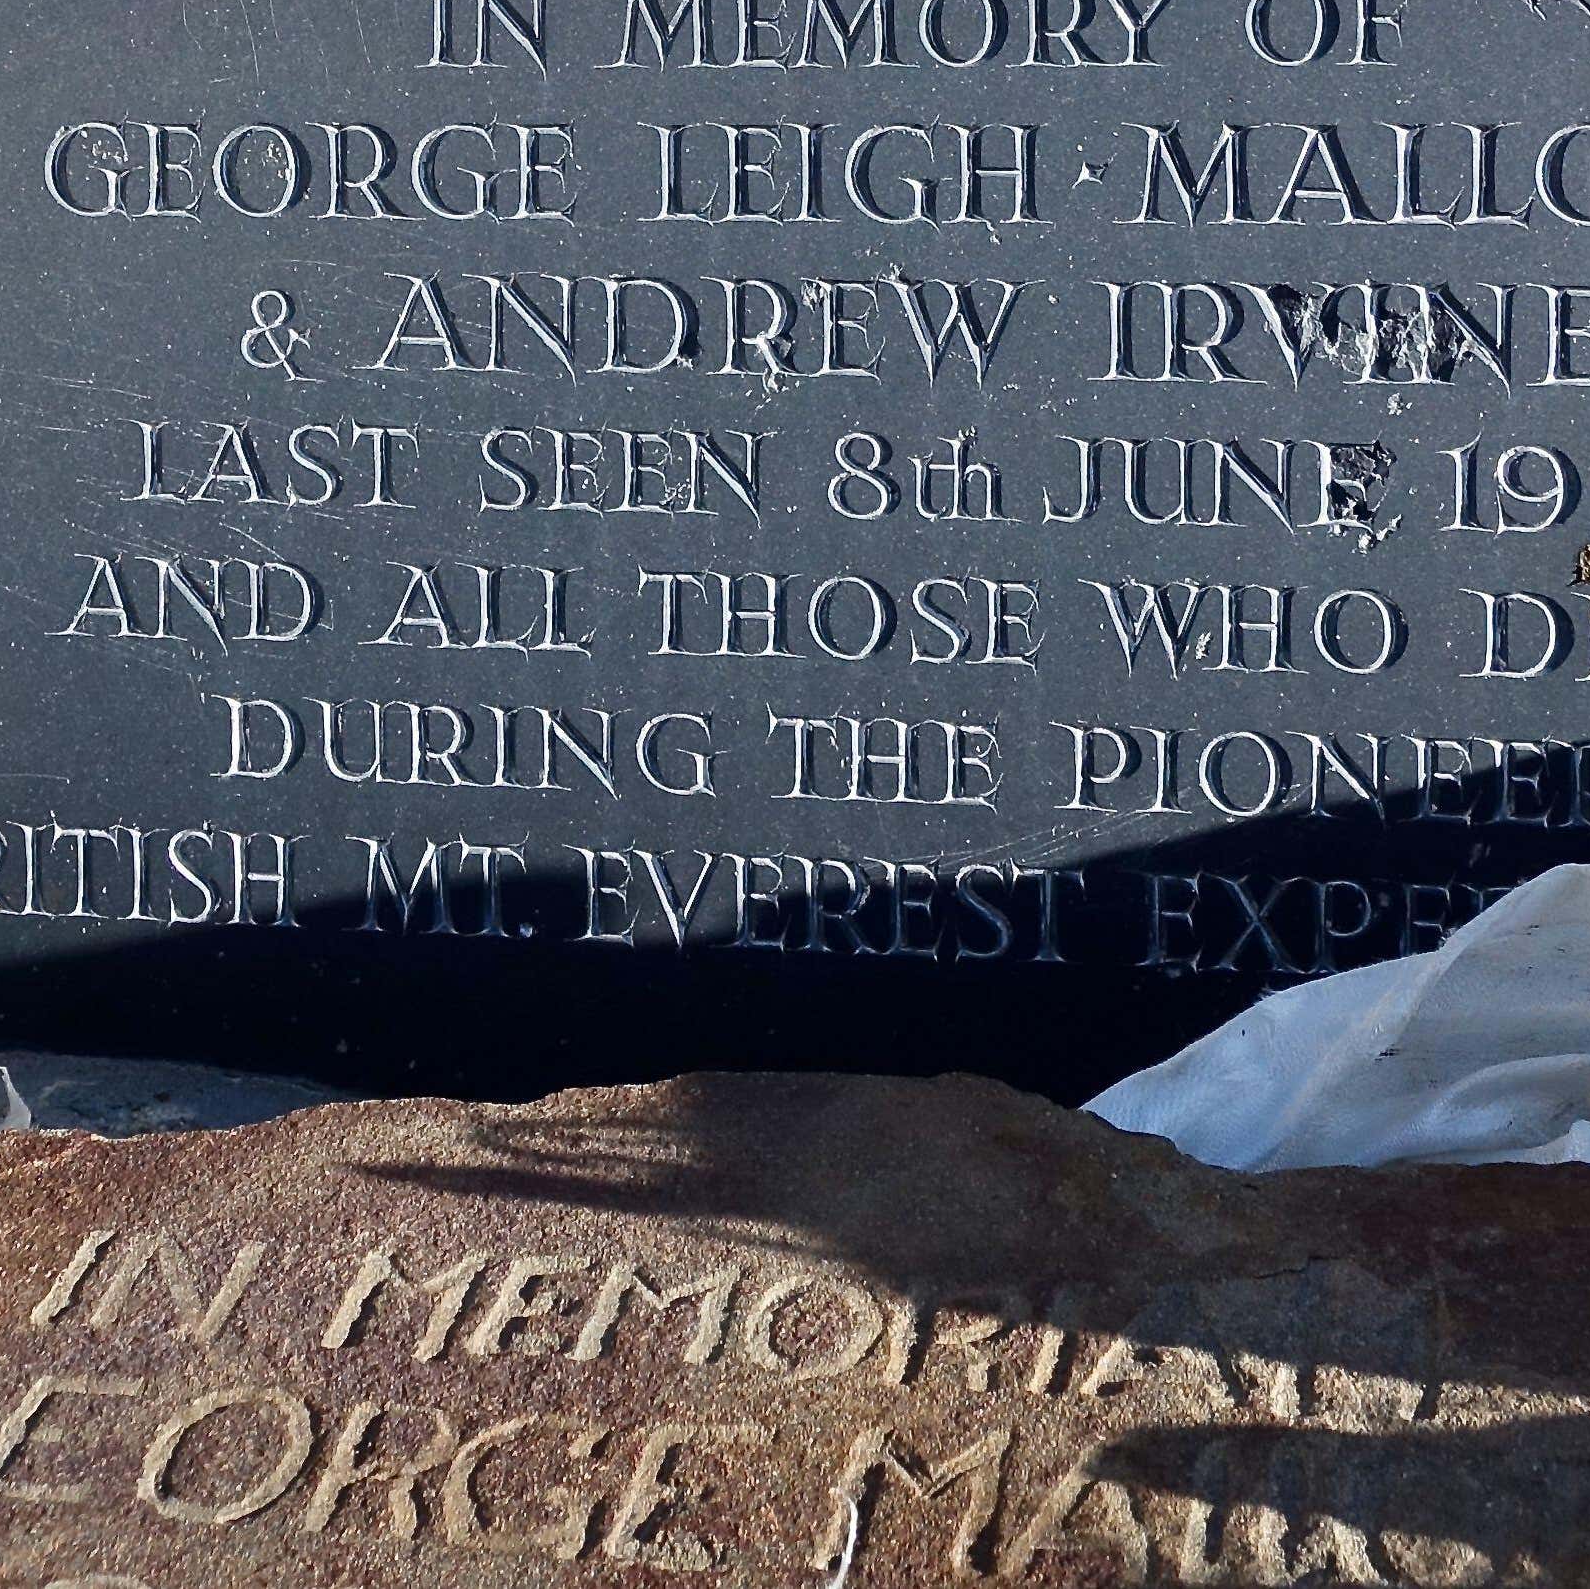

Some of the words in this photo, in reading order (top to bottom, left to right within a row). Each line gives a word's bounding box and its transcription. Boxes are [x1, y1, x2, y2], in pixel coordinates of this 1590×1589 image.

[43, 116, 578, 222] GEORGE
[636, 116, 1054, 226] LEIGH
[239, 288, 323, 382] &
[353, 271, 1046, 389] ANDREW
[120, 418, 420, 510] LAST
[478, 424, 779, 521] SEEN
[824, 426, 1003, 522] 8th
[1042, 432, 1396, 536] JUNE
[43, 553, 333, 655] AND
[357, 560, 594, 657] ALL
[637, 564, 1045, 668] THOSE
[1078, 578, 1409, 678] WHO
[210, 694, 729, 801] DURING
[767, 704, 1003, 810] THE
[343, 832, 536, 939] MT.
[564, 844, 1089, 965] EVEREST
[31, 1228, 270, 1338] IN
